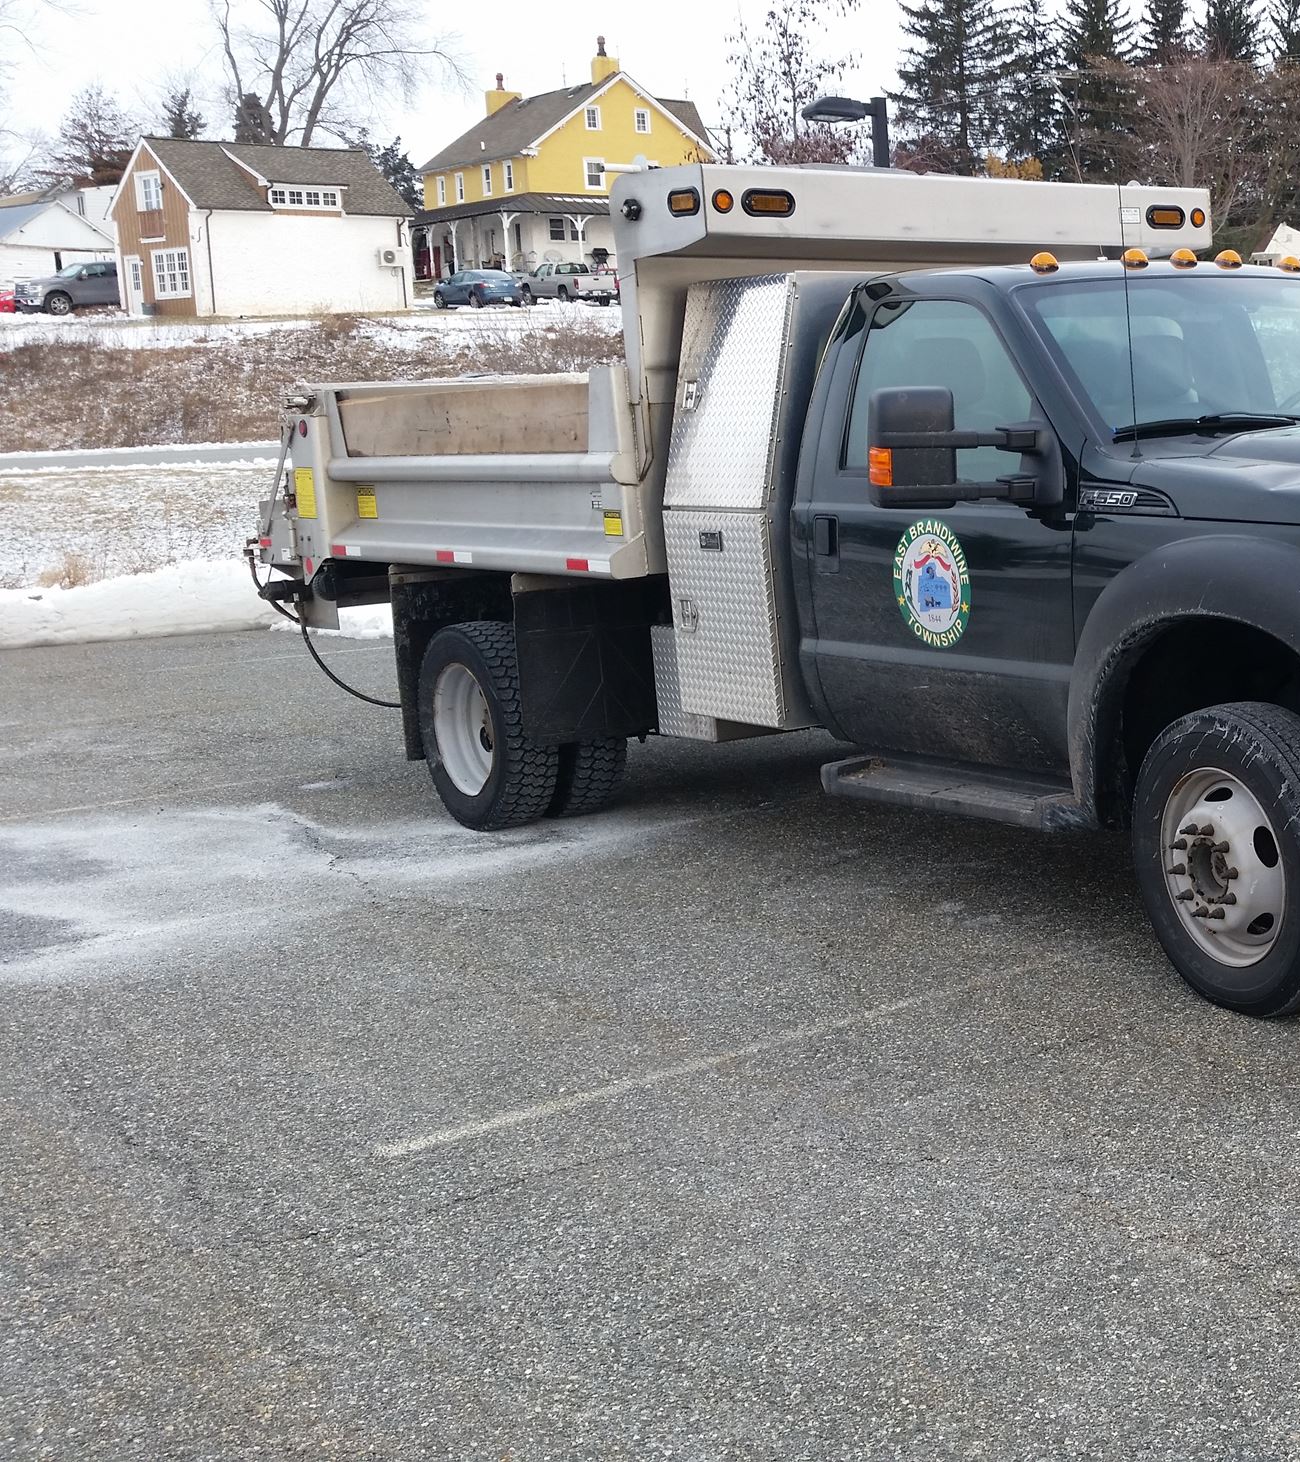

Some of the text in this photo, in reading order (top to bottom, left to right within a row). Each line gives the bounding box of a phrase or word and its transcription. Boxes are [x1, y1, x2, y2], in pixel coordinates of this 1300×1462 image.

[893, 520, 970, 586] EAST BRANDYWINE
[908, 613, 964, 647] TOWNSHIP
